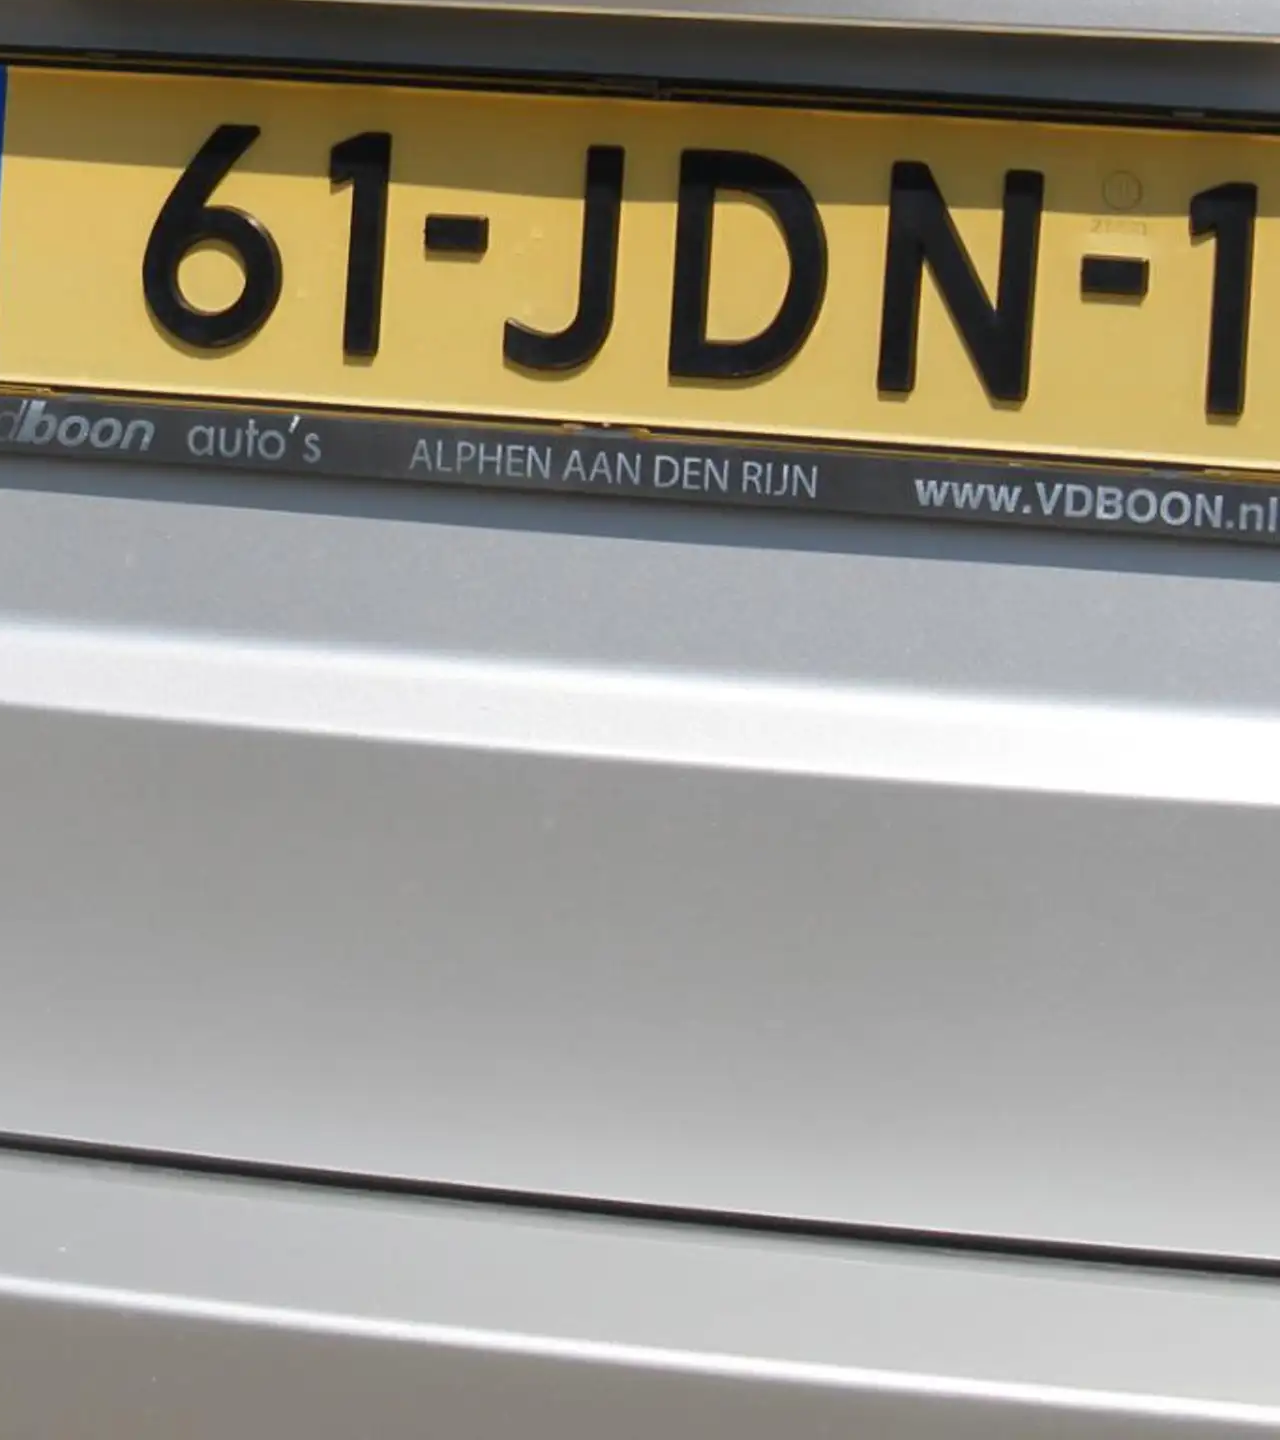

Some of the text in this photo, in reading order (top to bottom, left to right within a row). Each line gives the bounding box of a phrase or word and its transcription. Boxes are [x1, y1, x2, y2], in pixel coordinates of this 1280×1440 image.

[141, 122, 1258, 426] 61-JDN-1
[186, 413, 323, 464] auto's
[408, 437, 819, 499] ALPHEN AAN DEN RIJN
[913, 477, 1278, 533] www.VDBOON.nl
